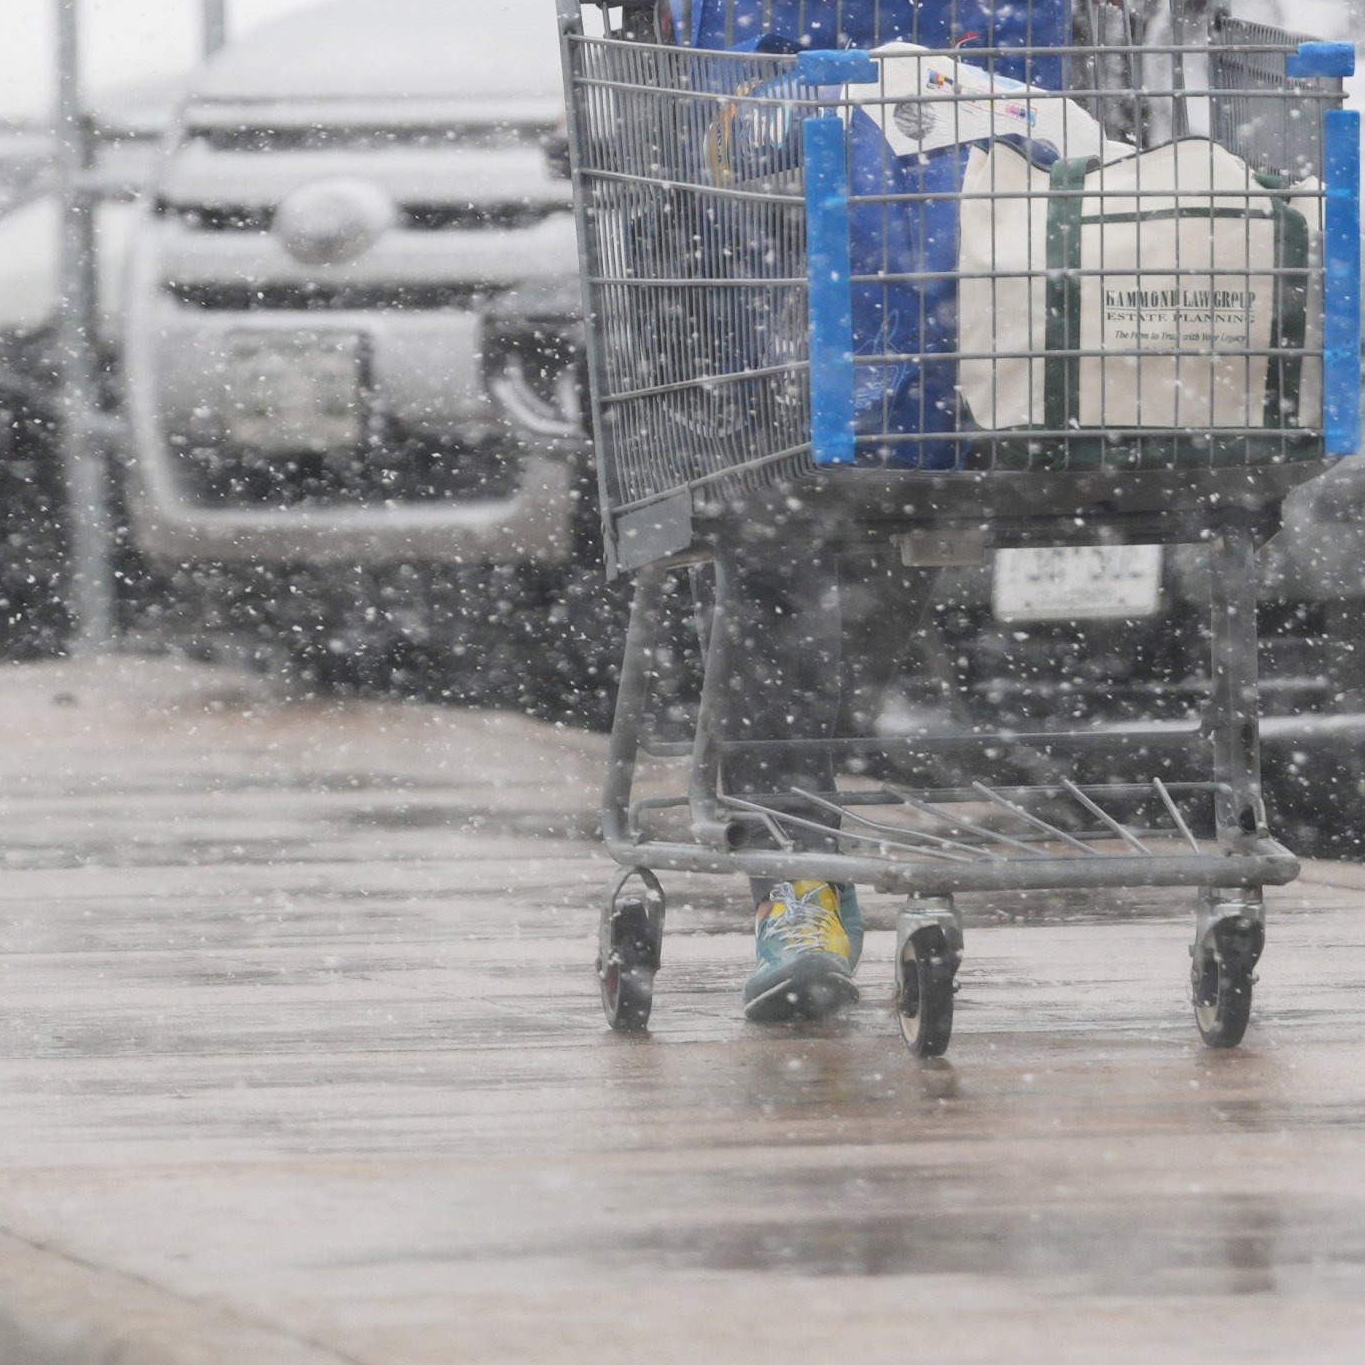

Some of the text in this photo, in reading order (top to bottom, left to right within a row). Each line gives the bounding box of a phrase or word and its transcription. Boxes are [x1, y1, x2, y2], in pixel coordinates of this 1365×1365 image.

[1183, 290, 1210, 307] LAW
[1106, 311, 1255, 323] ESTATE PLANNING
[1115, 330, 1129, 339] The
[1130, 331, 1149, 340] Frm
[1161, 332, 1180, 341] Tru
[1202, 332, 1219, 341] Yor
